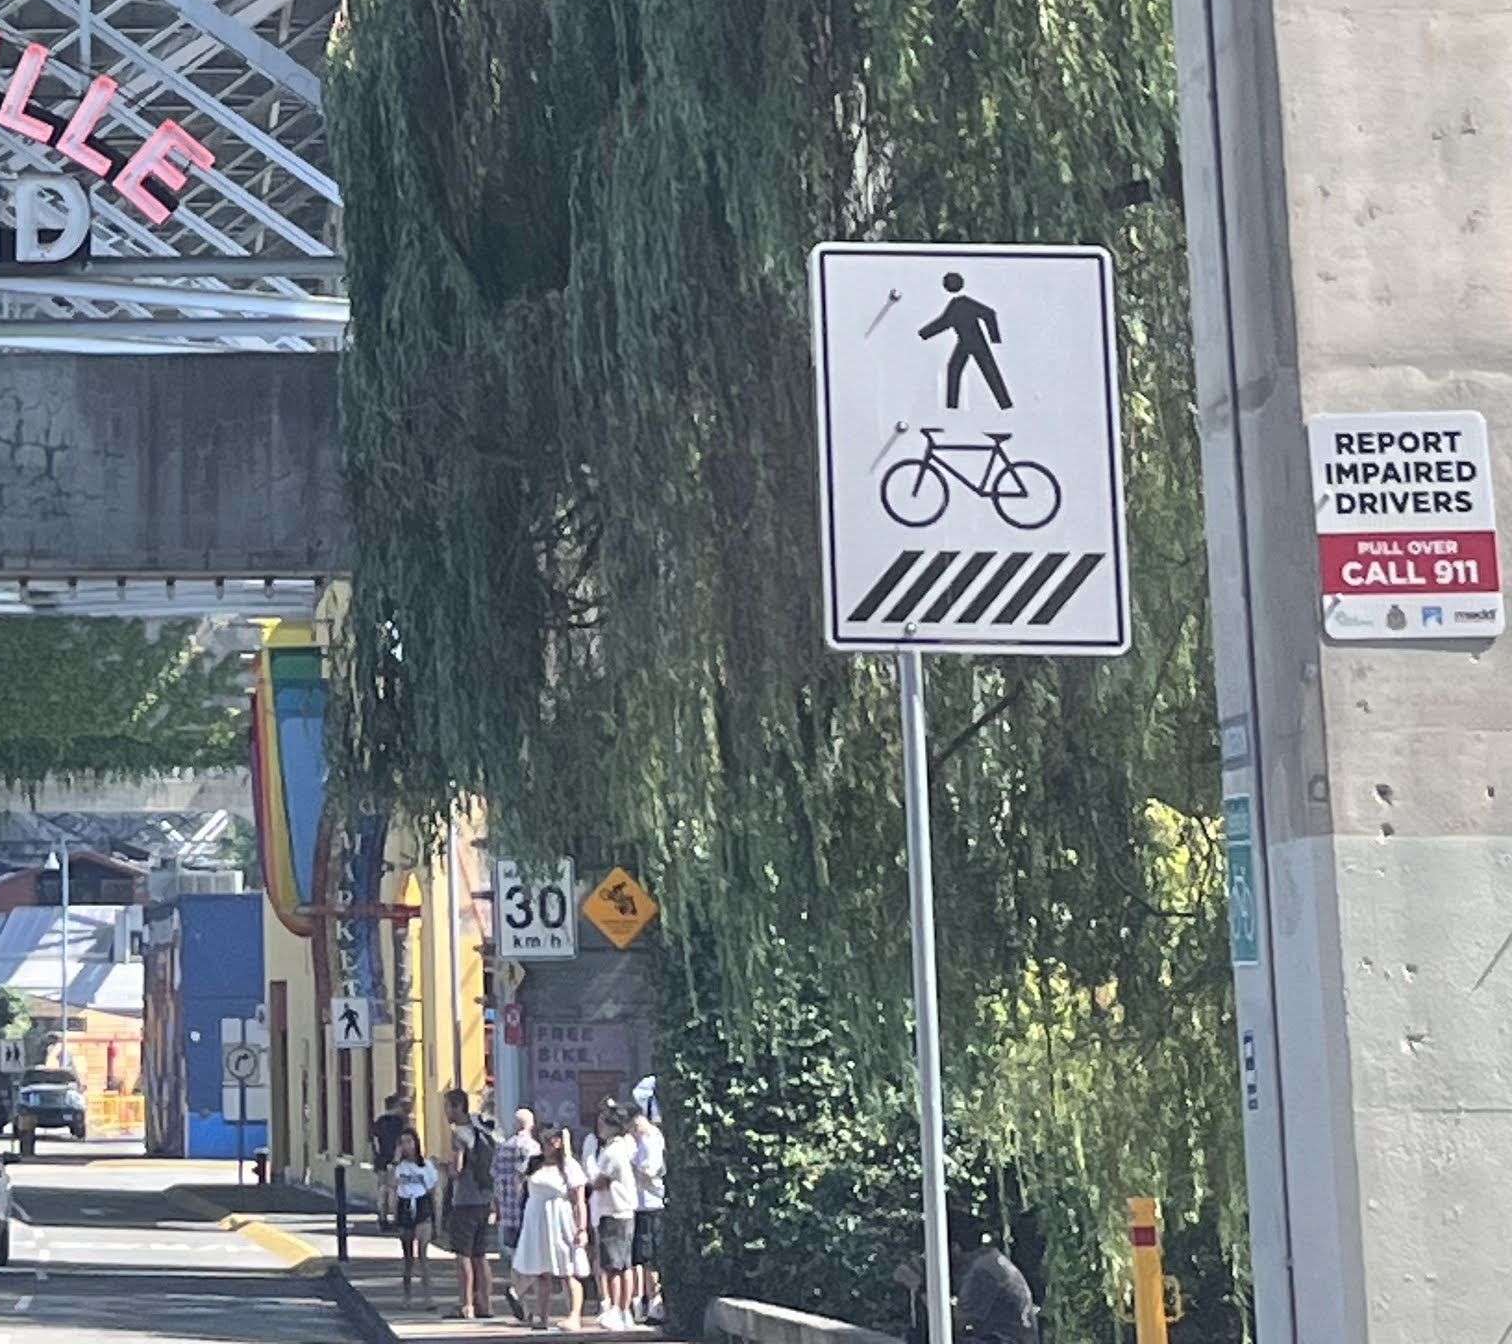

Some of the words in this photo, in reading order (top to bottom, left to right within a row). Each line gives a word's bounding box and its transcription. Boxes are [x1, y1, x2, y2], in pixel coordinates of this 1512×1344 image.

[1335, 431, 1462, 455] REPORT
[1325, 461, 1478, 485] IMPAIRED
[1336, 491, 1473, 514] DRIVERS
[1357, 541, 1403, 556] PULL
[1407, 540, 1459, 556] OVER
[1341, 561, 1426, 586] CALL
[1433, 559, 1480, 585] 911
[505, 885, 567, 929] 30
[512, 934, 562, 950] km/h
[537, 1026, 595, 1042] FREE
[537, 1047, 594, 1063] BIKE
